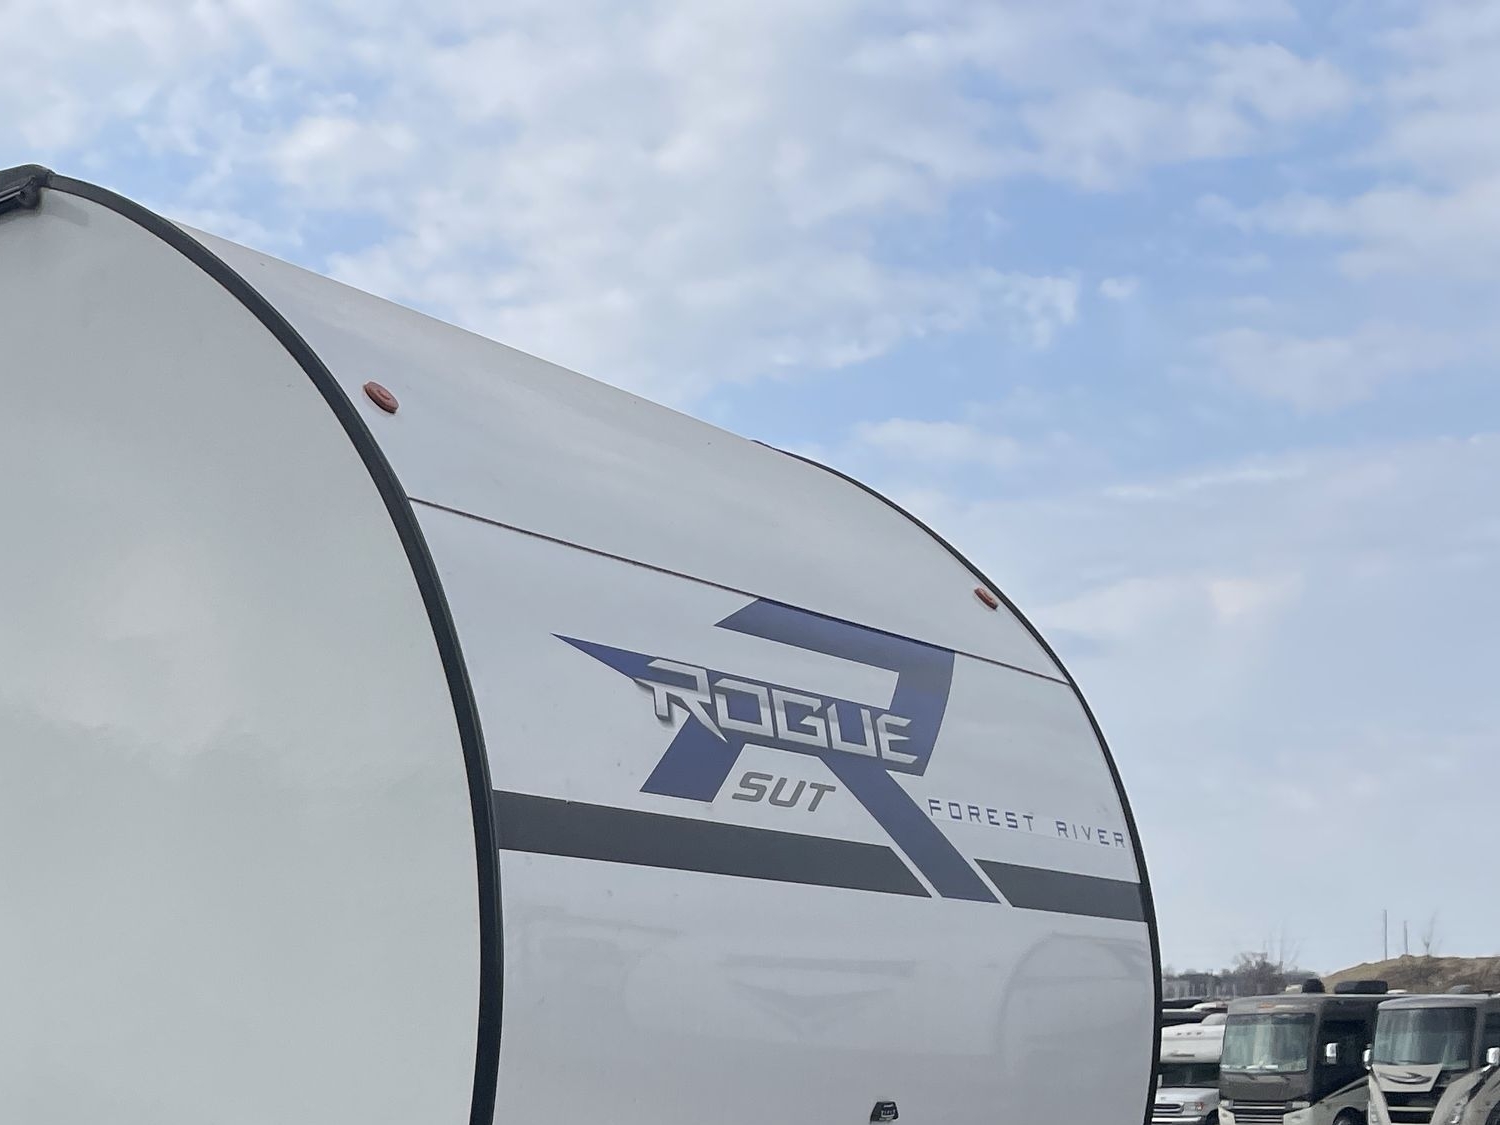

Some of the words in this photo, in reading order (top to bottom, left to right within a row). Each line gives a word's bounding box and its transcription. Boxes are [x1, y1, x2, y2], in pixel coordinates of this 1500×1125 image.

[633, 658, 919, 765] ROGUE
[732, 771, 837, 813] SUT
[927, 799, 1034, 832] FOREST
[1055, 820, 1126, 849] RIVER
